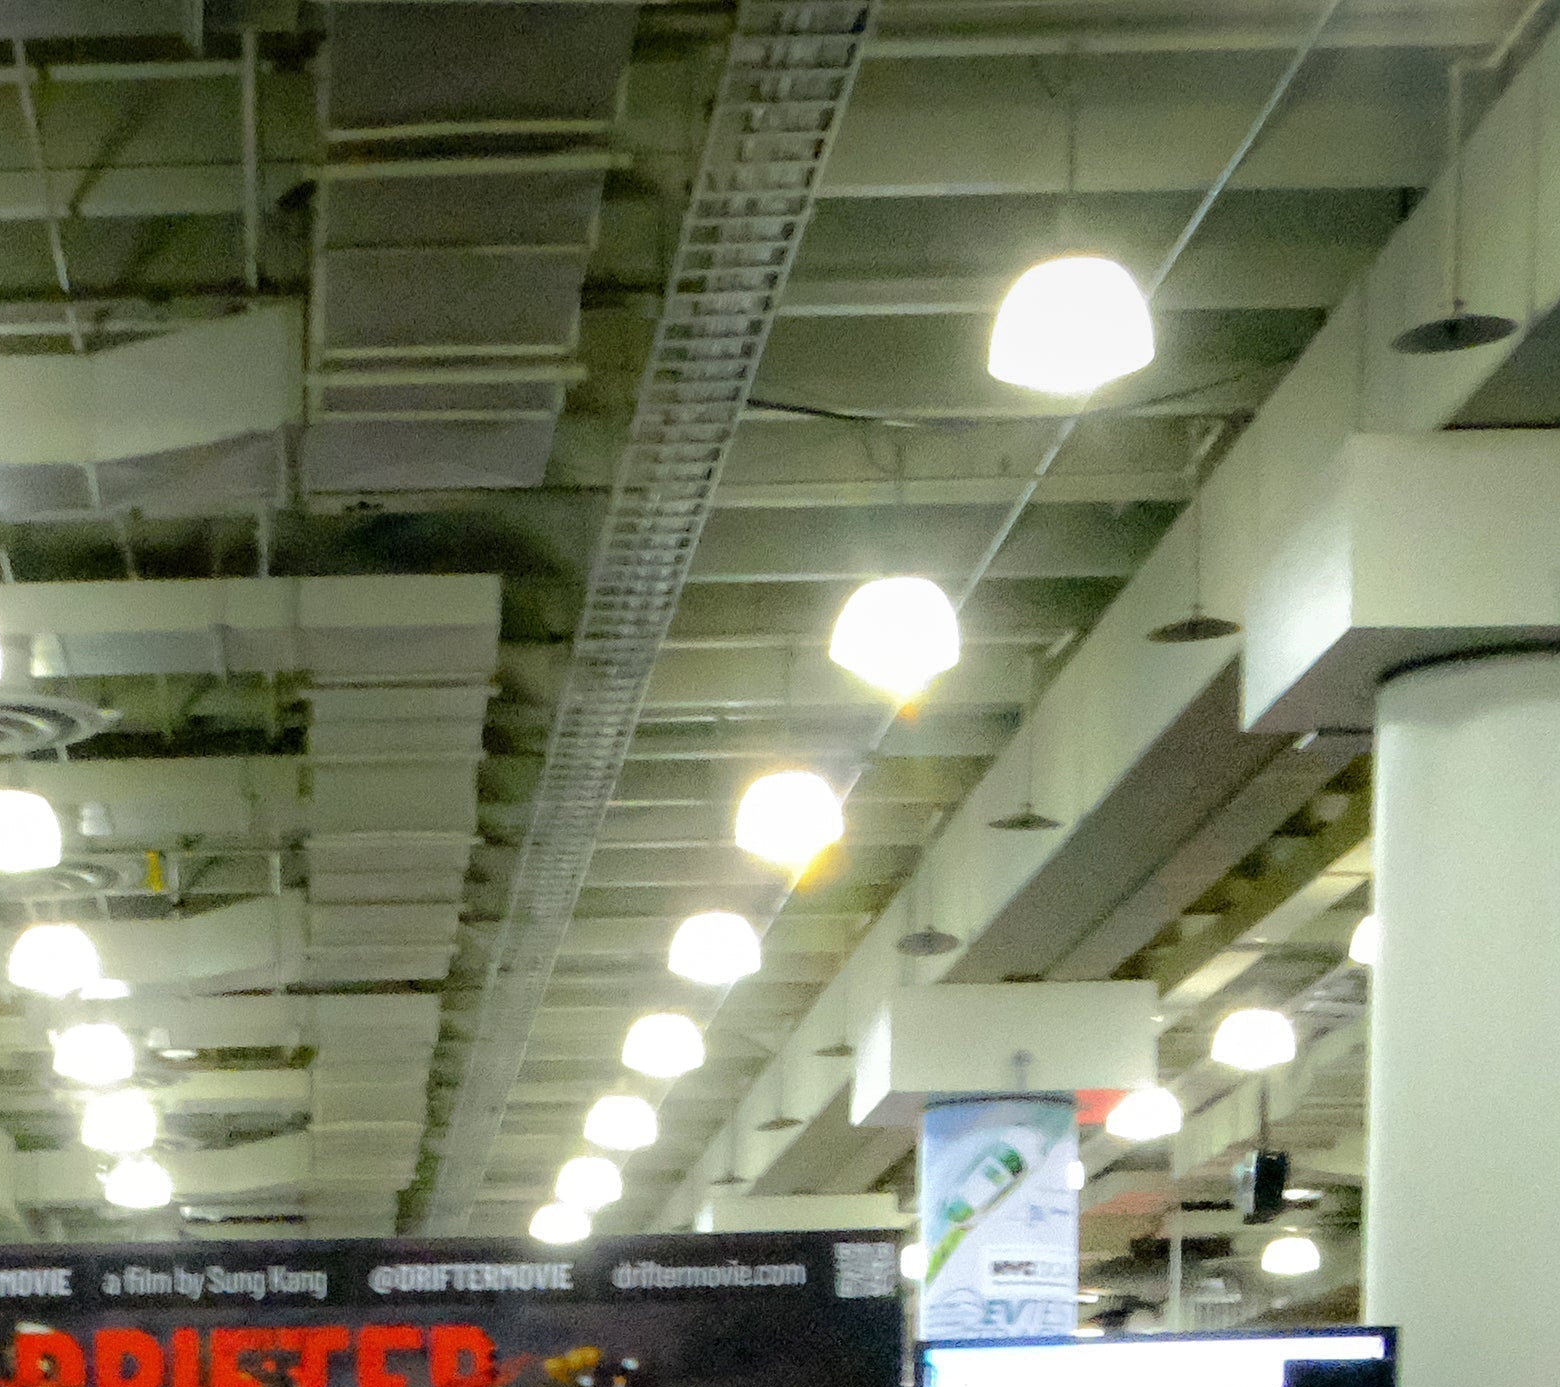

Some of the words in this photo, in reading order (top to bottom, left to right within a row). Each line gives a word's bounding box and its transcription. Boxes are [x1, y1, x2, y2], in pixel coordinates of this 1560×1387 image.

[123, 1264, 172, 1294] film
[174, 1265, 204, 1302] by
[206, 1264, 266, 1302] Sung
[267, 1263, 328, 1302] Kang
[611, 1261, 807, 1289] driftermovie.com
